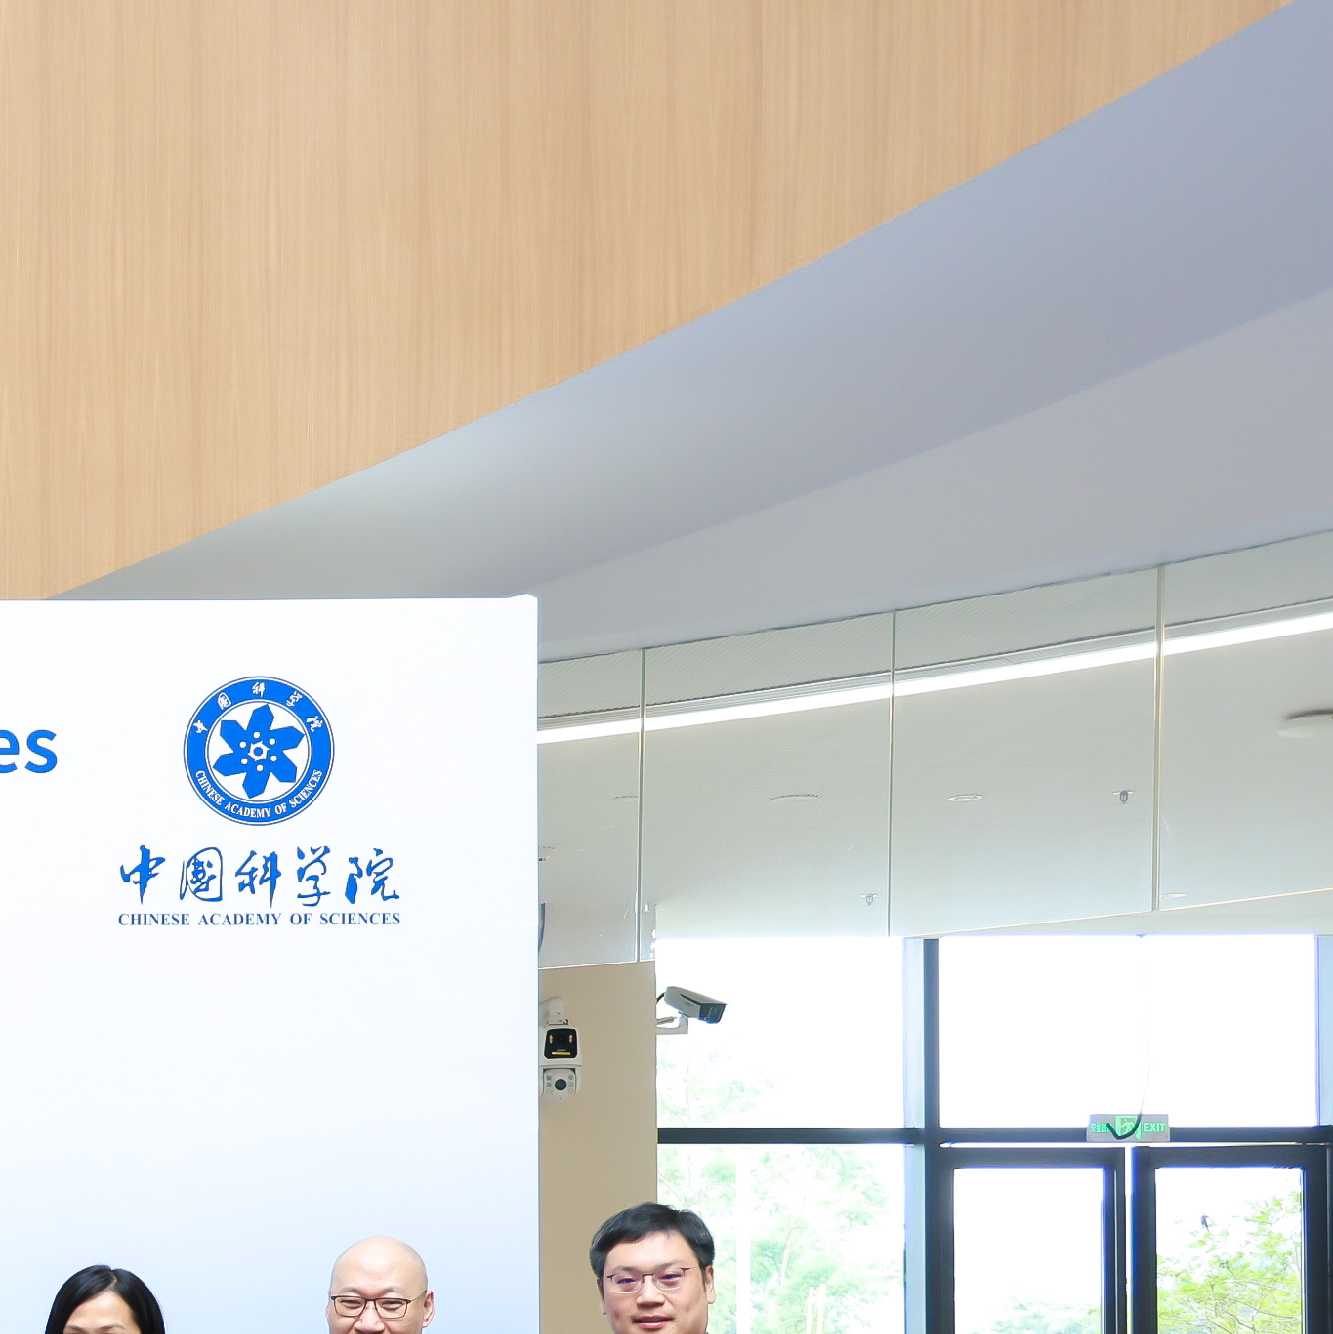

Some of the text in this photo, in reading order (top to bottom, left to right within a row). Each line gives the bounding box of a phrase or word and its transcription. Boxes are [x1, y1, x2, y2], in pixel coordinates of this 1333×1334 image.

[195, 769, 323, 818] CHINESE ACADEMY OF SCIENCES
[118, 912, 401, 926] CHINESE ACADEMY OF SCIENCES
[1144, 1122, 1165, 1132] EXIT
